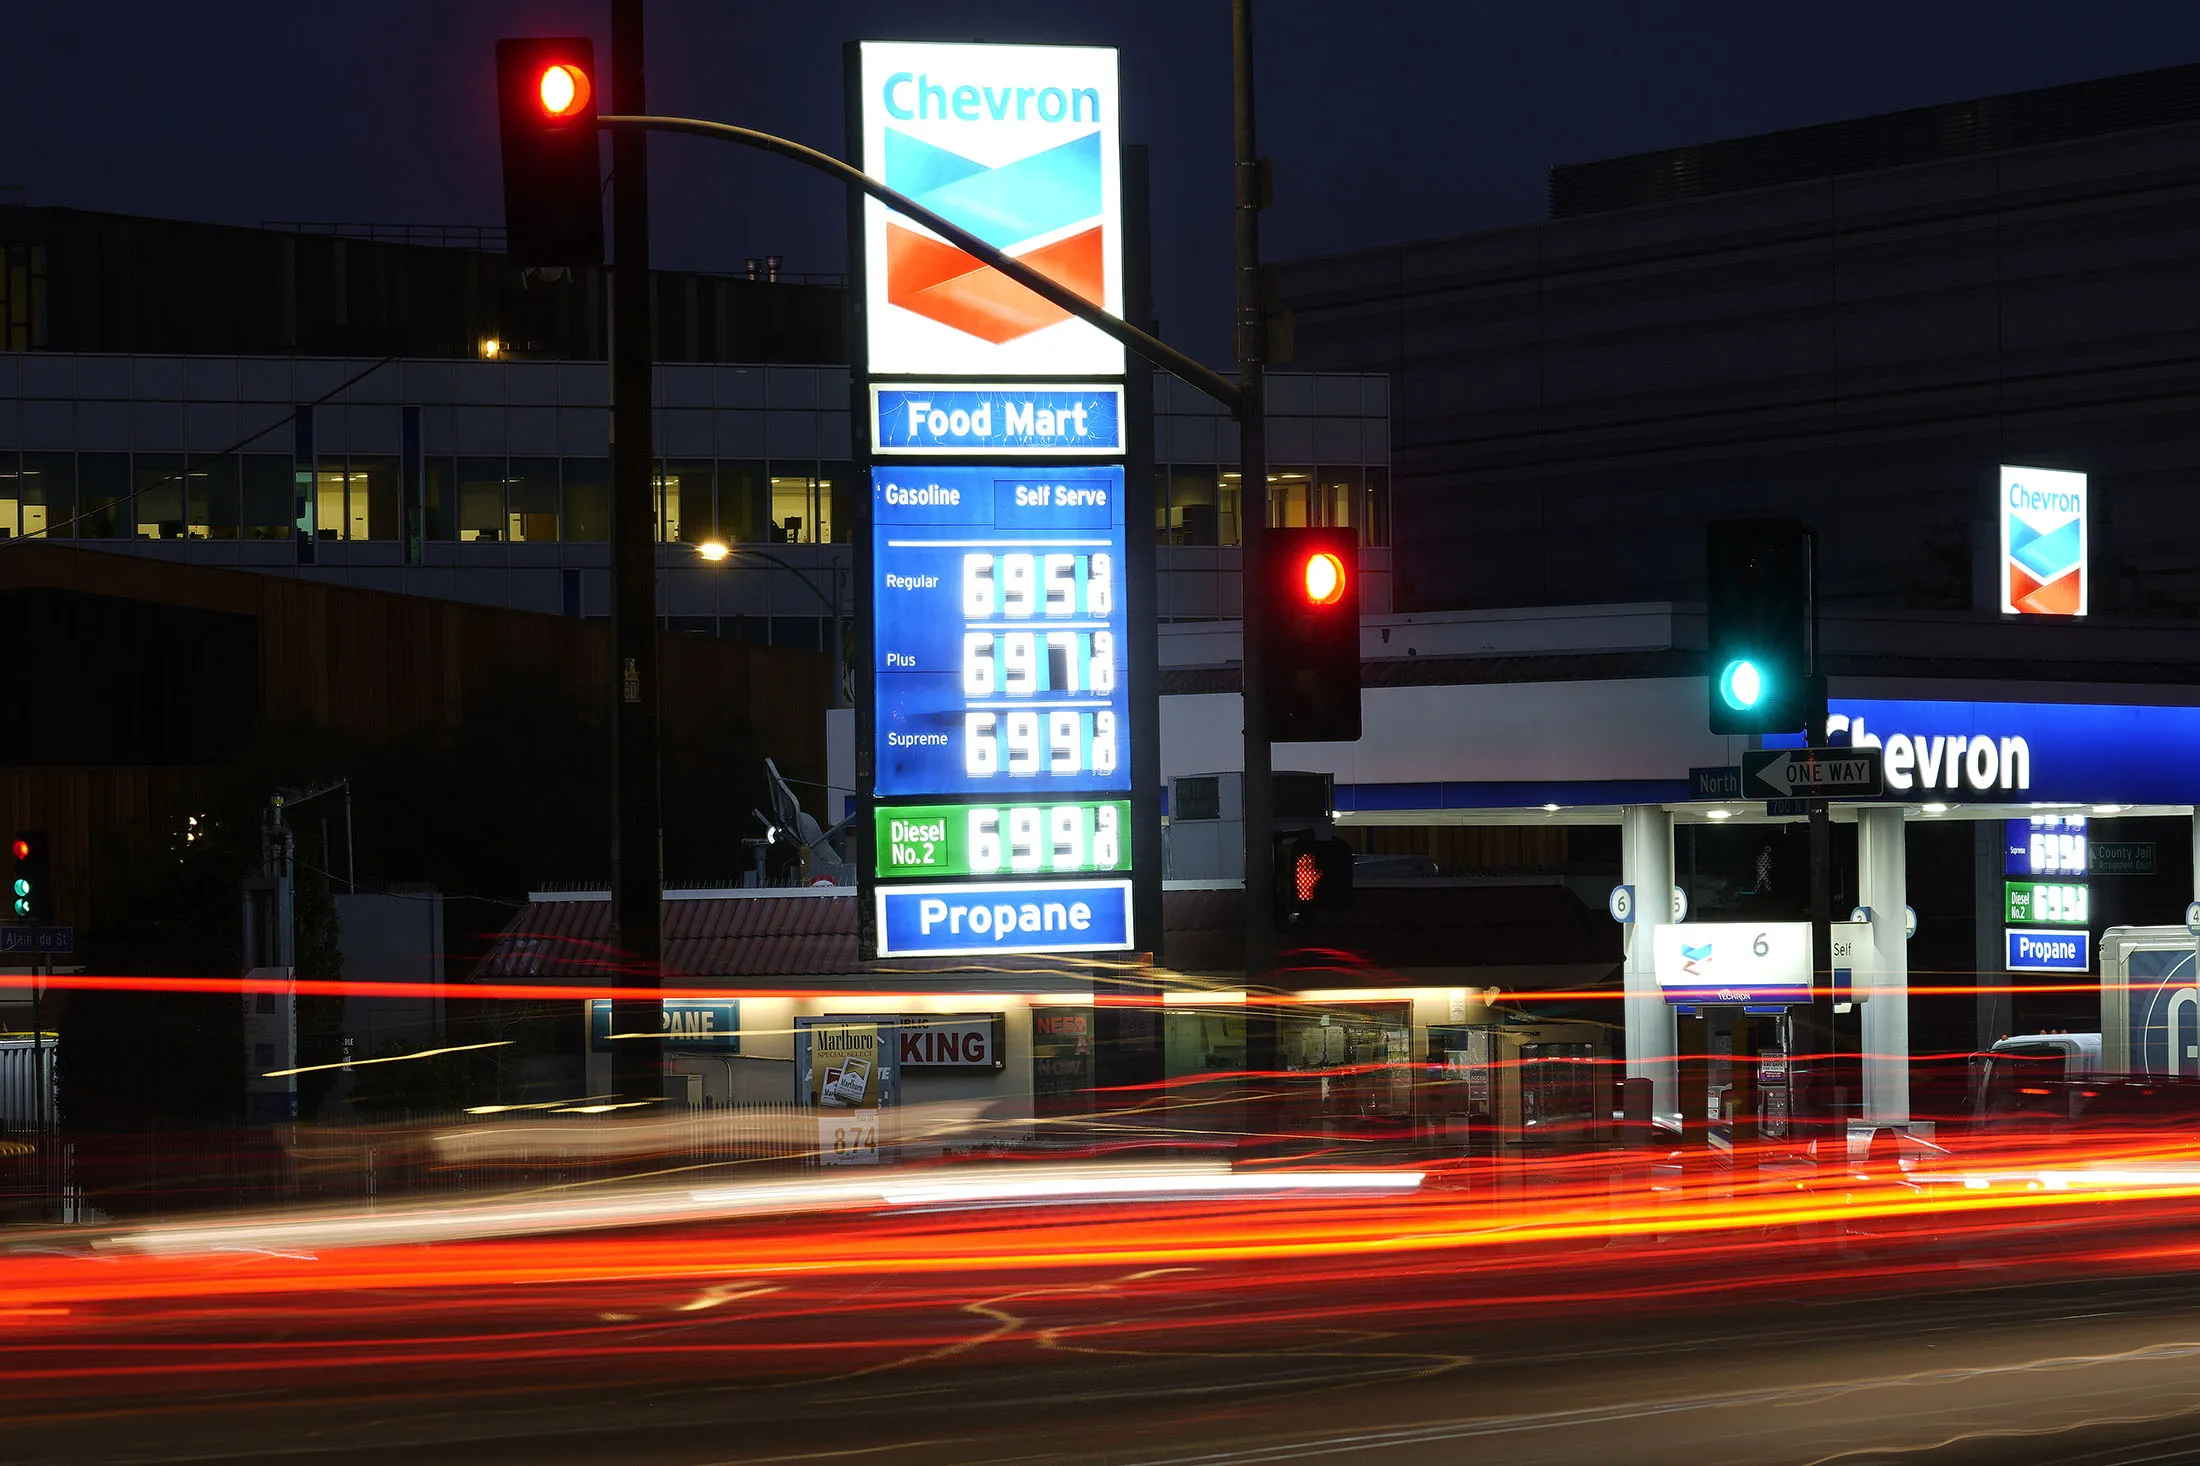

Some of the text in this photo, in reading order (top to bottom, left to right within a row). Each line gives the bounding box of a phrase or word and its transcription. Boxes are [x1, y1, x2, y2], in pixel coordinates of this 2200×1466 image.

[883, 72, 1101, 123] Chevron
[908, 402, 1088, 437] Food Mart
[886, 484, 961, 505] Gasoline
[1015, 487, 1107, 506] Self Serve
[2010, 483, 2080, 513] Chevron
[886, 574, 939, 590] Regular
[887, 653, 916, 667] Plus
[888, 733, 948, 749] Supreme
[1827, 714, 2030, 789] evron
[1700, 773, 1738, 793] North
[1786, 762, 1865, 783] ONE WAY
[891, 820, 945, 843] Diesel
[892, 843, 935, 864] No. 2
[2100, 846, 2152, 860] County Jail
[1618, 896, 1626, 912] 6
[2011, 892, 2030, 905] Diesel
[920, 901, 1092, 940] Propane
[2193, 910, 2200, 923] 4
[6, 932, 67, 946] Alamda St
[1753, 933, 1769, 957] 6
[1833, 942, 1852, 957] Self
[2019, 937, 2076, 963] Propane
[1036, 1016, 1087, 1034] NEED
[817, 1024, 873, 1051] Marlboro
[900, 1032, 985, 1063] KING
[833, 1126, 876, 1156] 8.74
